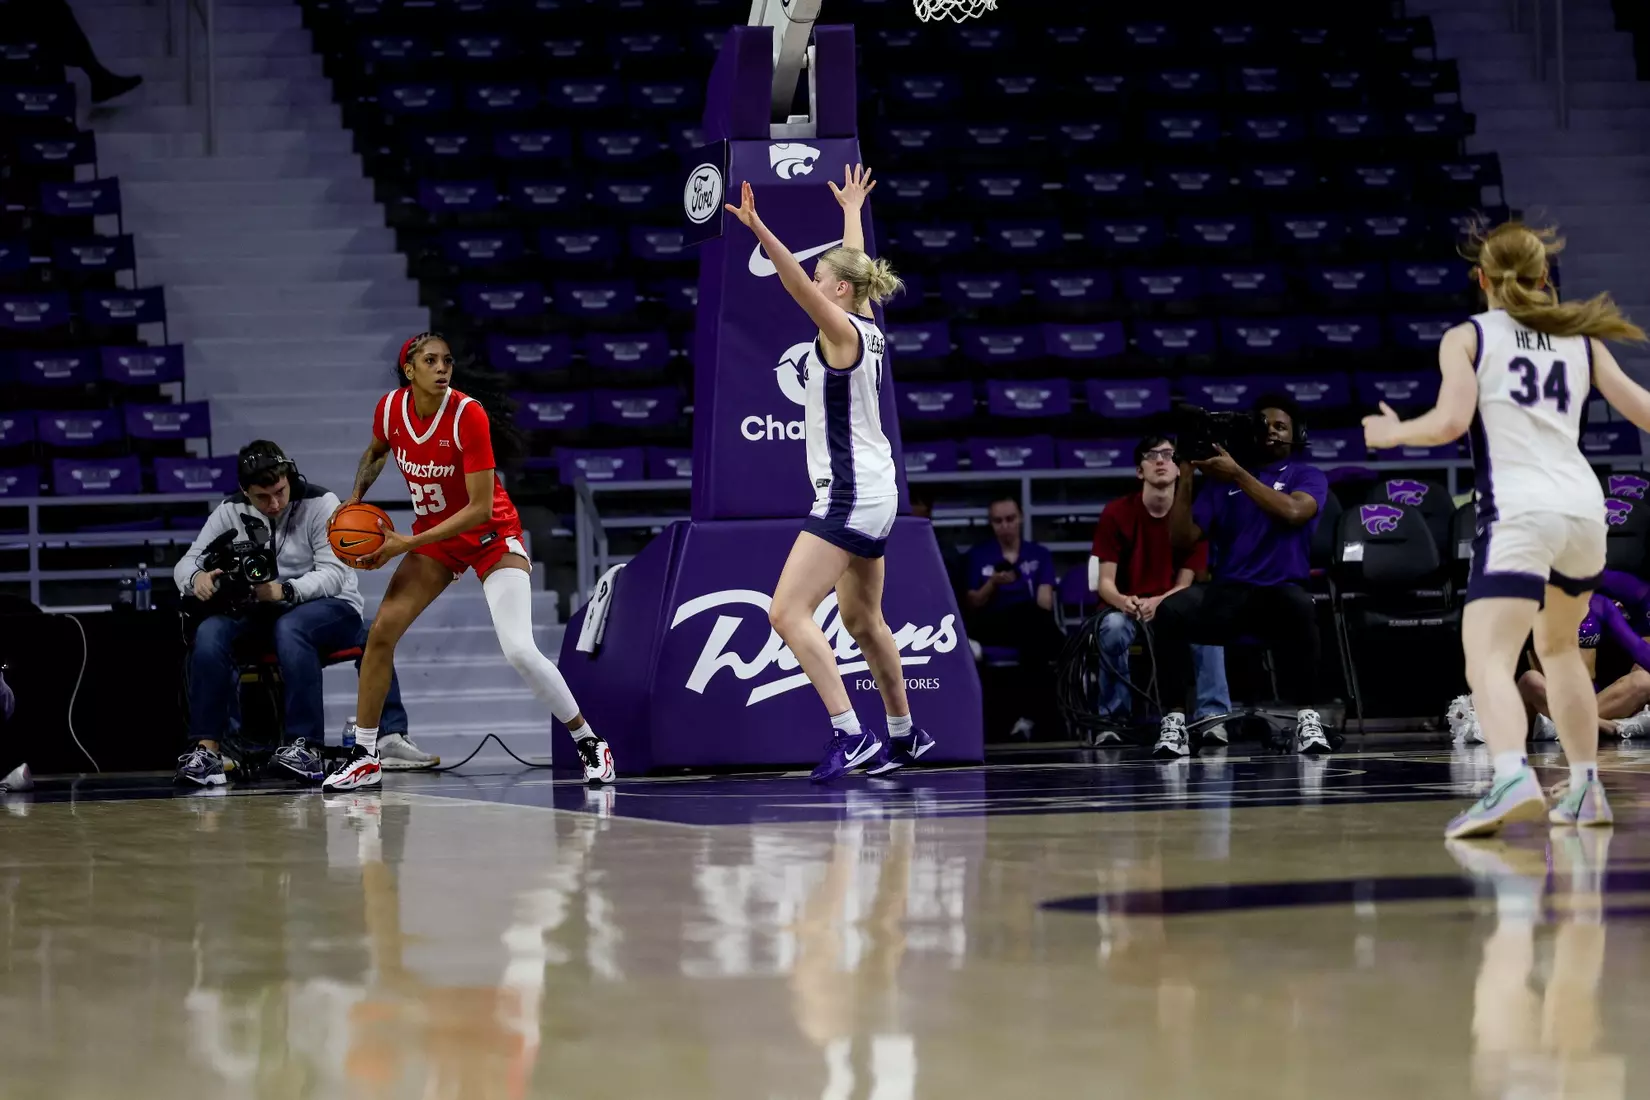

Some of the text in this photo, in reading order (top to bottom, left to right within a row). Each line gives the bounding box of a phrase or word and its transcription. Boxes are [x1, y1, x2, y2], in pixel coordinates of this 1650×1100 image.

[692, 174, 715, 212] Ford
[1515, 329, 1557, 352] HEAL
[1508, 356, 1570, 414] 34
[397, 446, 455, 478] Houston
[408, 481, 447, 515] 23
[903, 678, 940, 689] TORES
